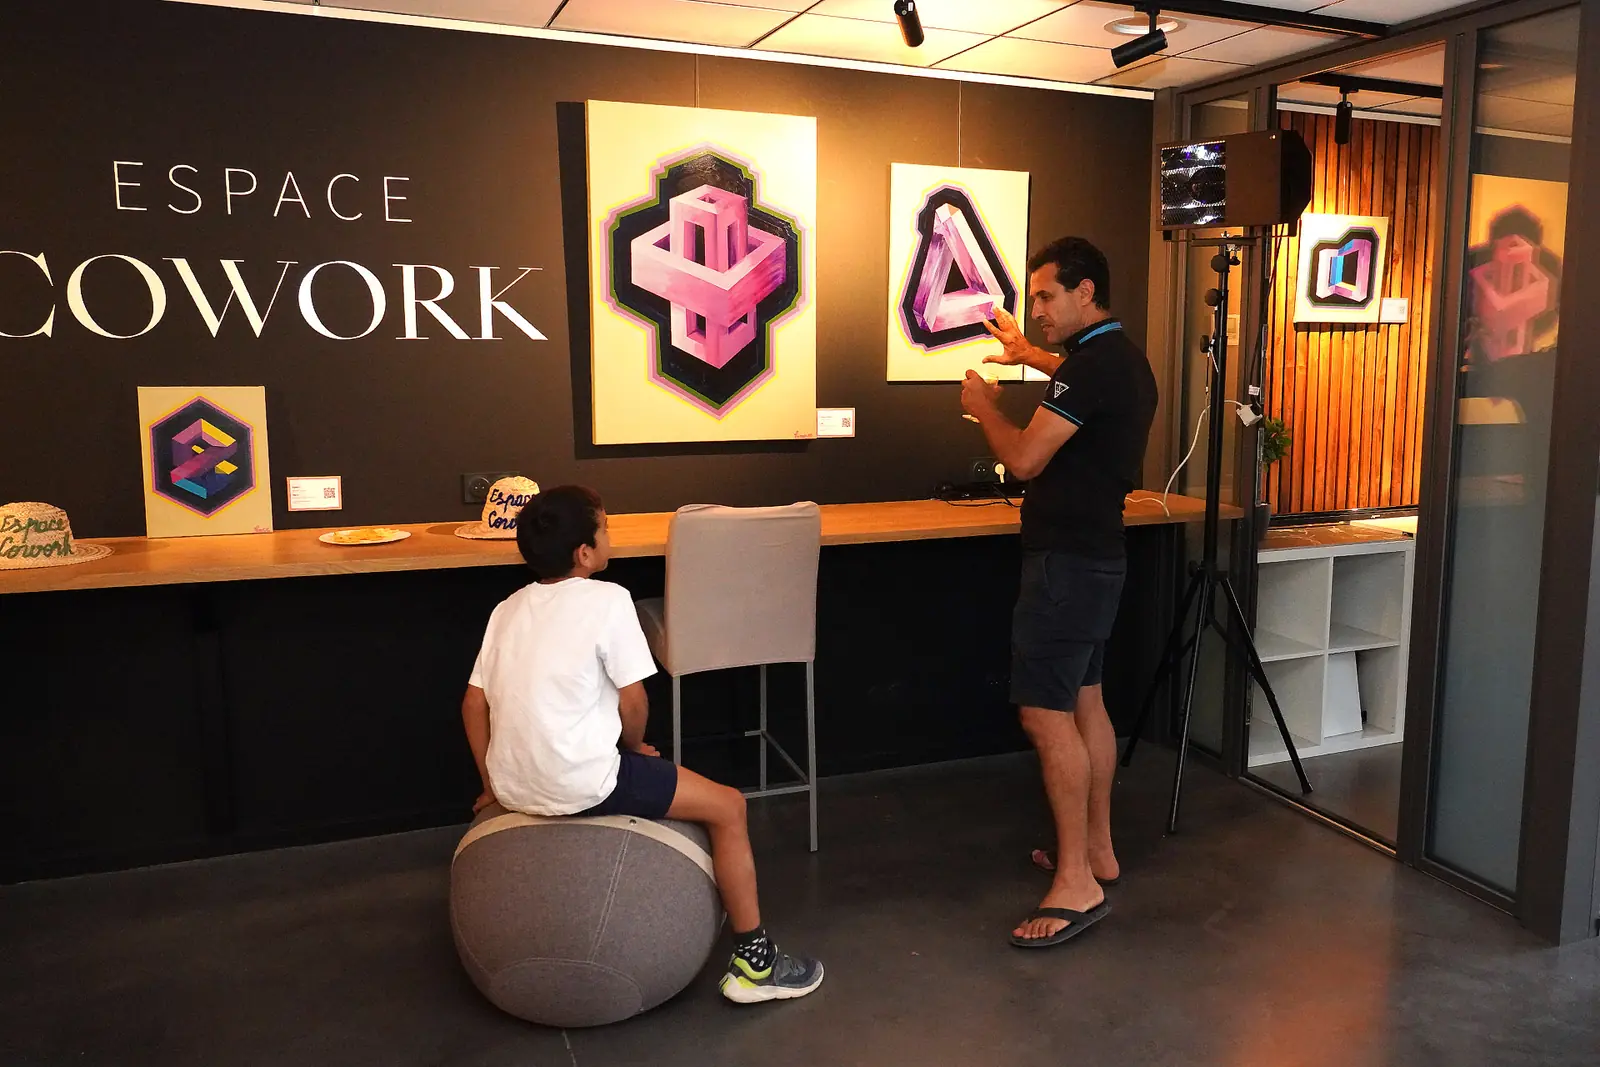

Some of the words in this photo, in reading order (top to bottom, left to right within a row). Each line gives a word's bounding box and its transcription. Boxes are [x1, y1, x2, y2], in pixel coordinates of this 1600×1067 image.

[113, 160, 413, 223] ESPACE
[0, 250, 548, 340] COWORK
[0, 515, 66, 543] Espace
[0, 532, 74, 558] Cowork
